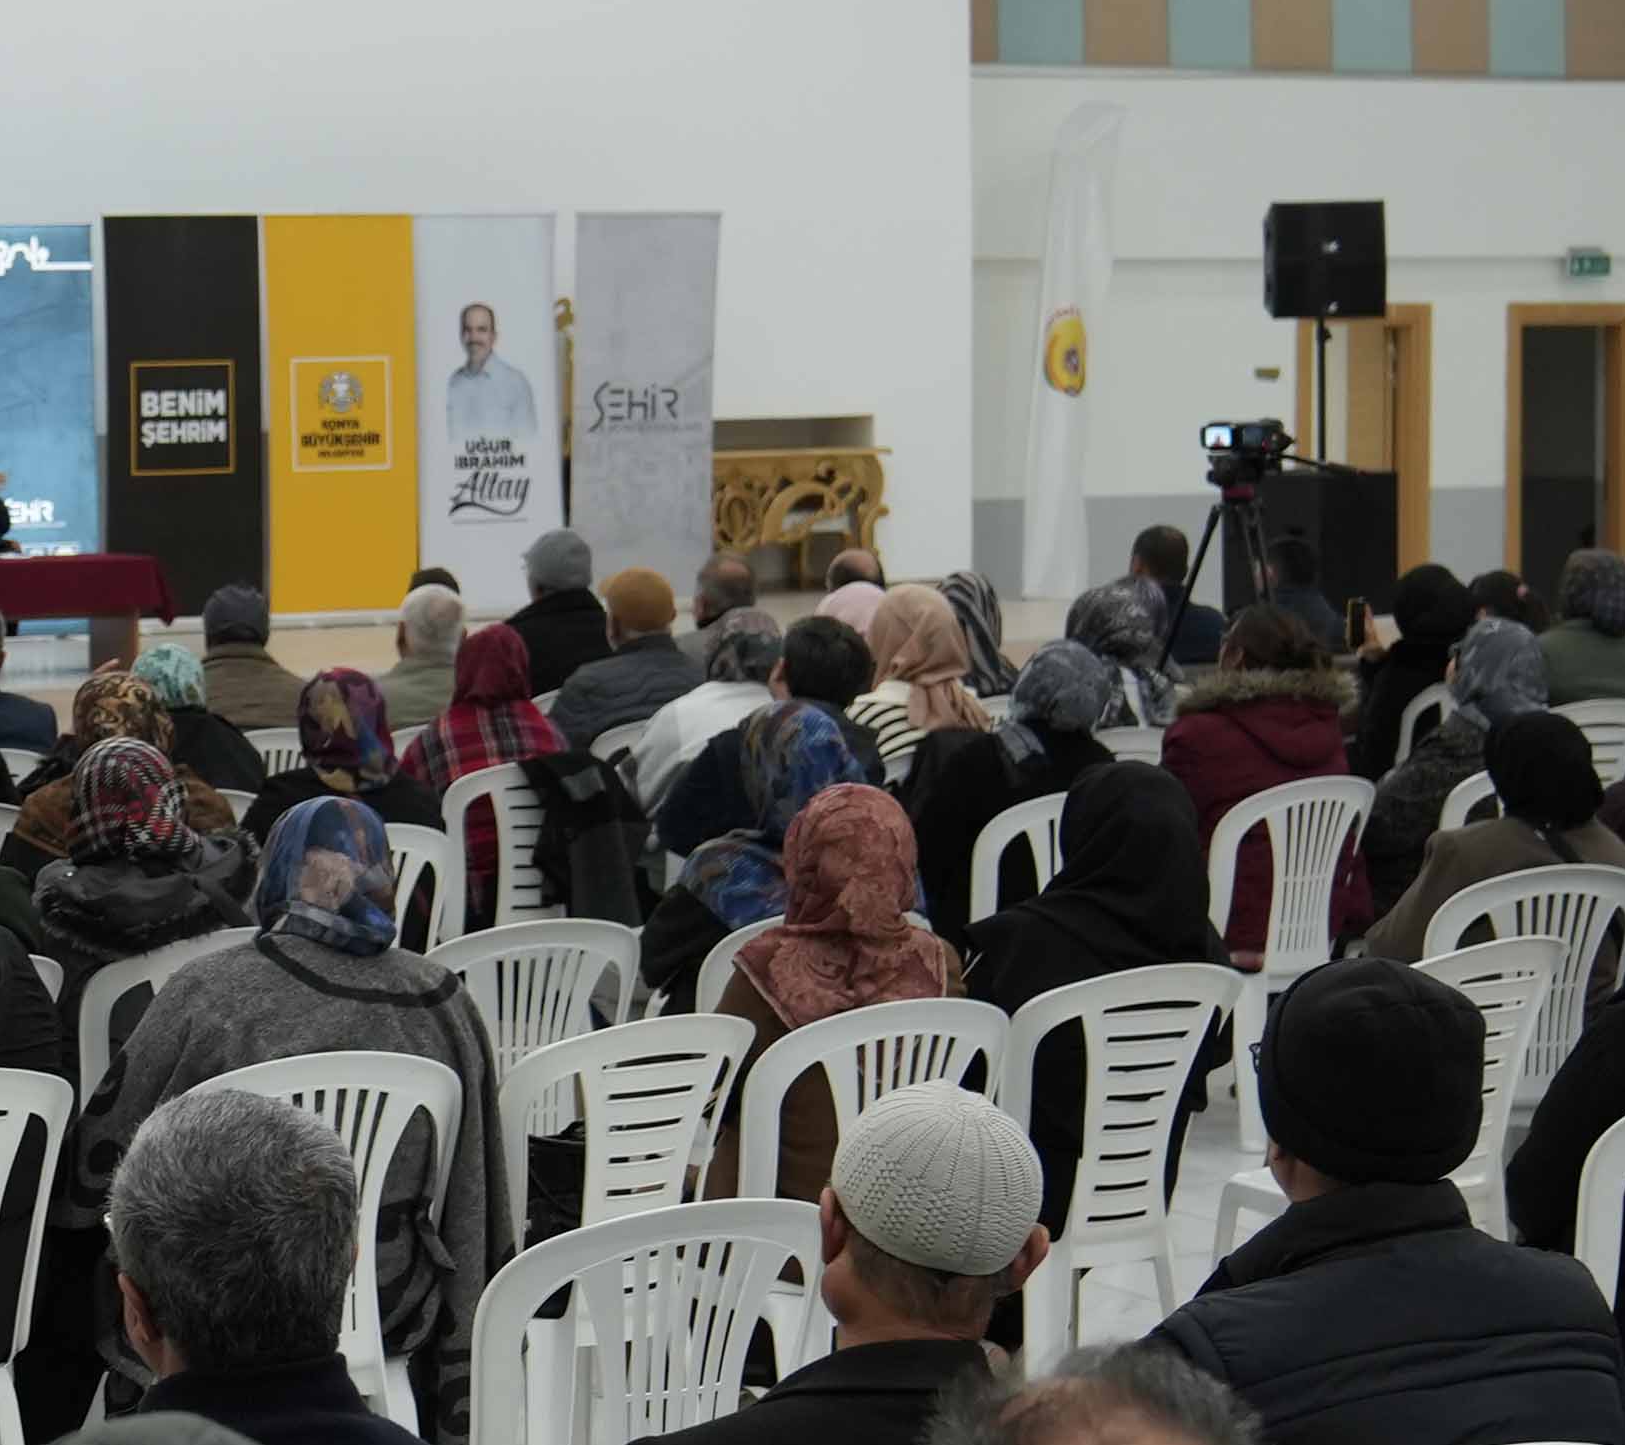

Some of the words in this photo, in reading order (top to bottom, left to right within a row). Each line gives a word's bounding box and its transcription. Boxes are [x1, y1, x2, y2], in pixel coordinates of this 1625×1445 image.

[141, 389, 227, 418] BENİM
[141, 419, 228, 449] ŞEHRİM
[465, 437, 512, 454] UĞUR
